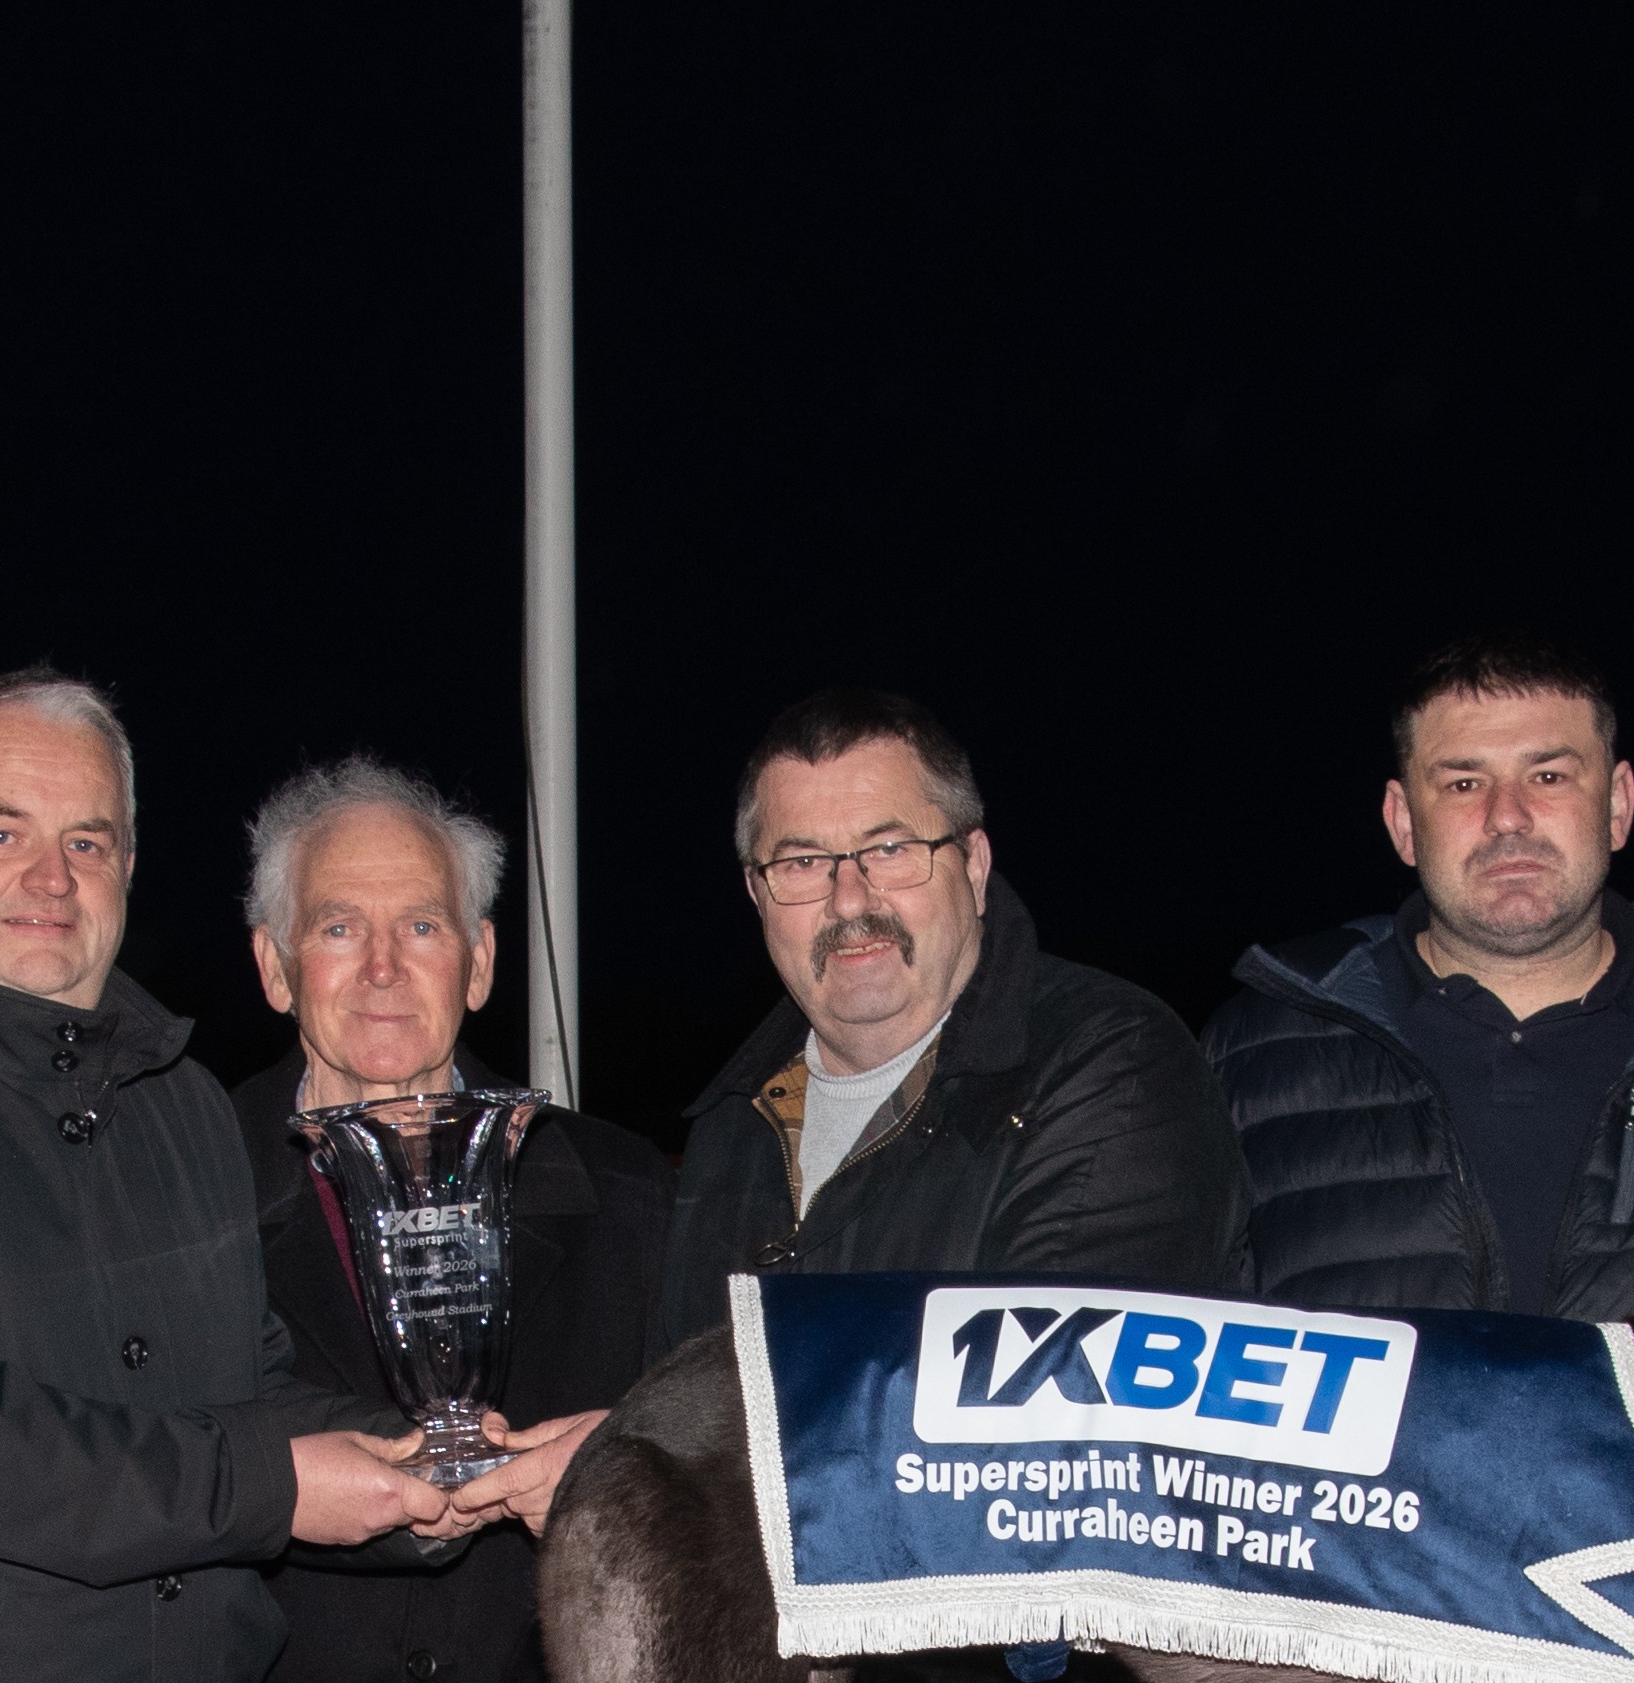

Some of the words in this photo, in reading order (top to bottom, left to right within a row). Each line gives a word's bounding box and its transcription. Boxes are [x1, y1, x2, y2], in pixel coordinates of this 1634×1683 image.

[382, 1203, 481, 1235] 1XBET
[394, 1232, 468, 1248] Supersprint
[394, 1265, 441, 1278] Winner
[443, 1259, 477, 1274] 2026
[394, 1284, 453, 1300] Curraheen
[454, 1281, 480, 1294] Park
[385, 1305, 445, 1321] Greyhound
[447, 1302, 494, 1316] Stadium
[952, 1306, 1391, 1435] 1XBET
[895, 1450, 1141, 1500] Supersprint
[1153, 1455, 1302, 1516] Winner
[1311, 1480, 1420, 1532] 2026
[987, 1499, 1204, 1553] Curraheen
[1216, 1514, 1316, 1571] Park
